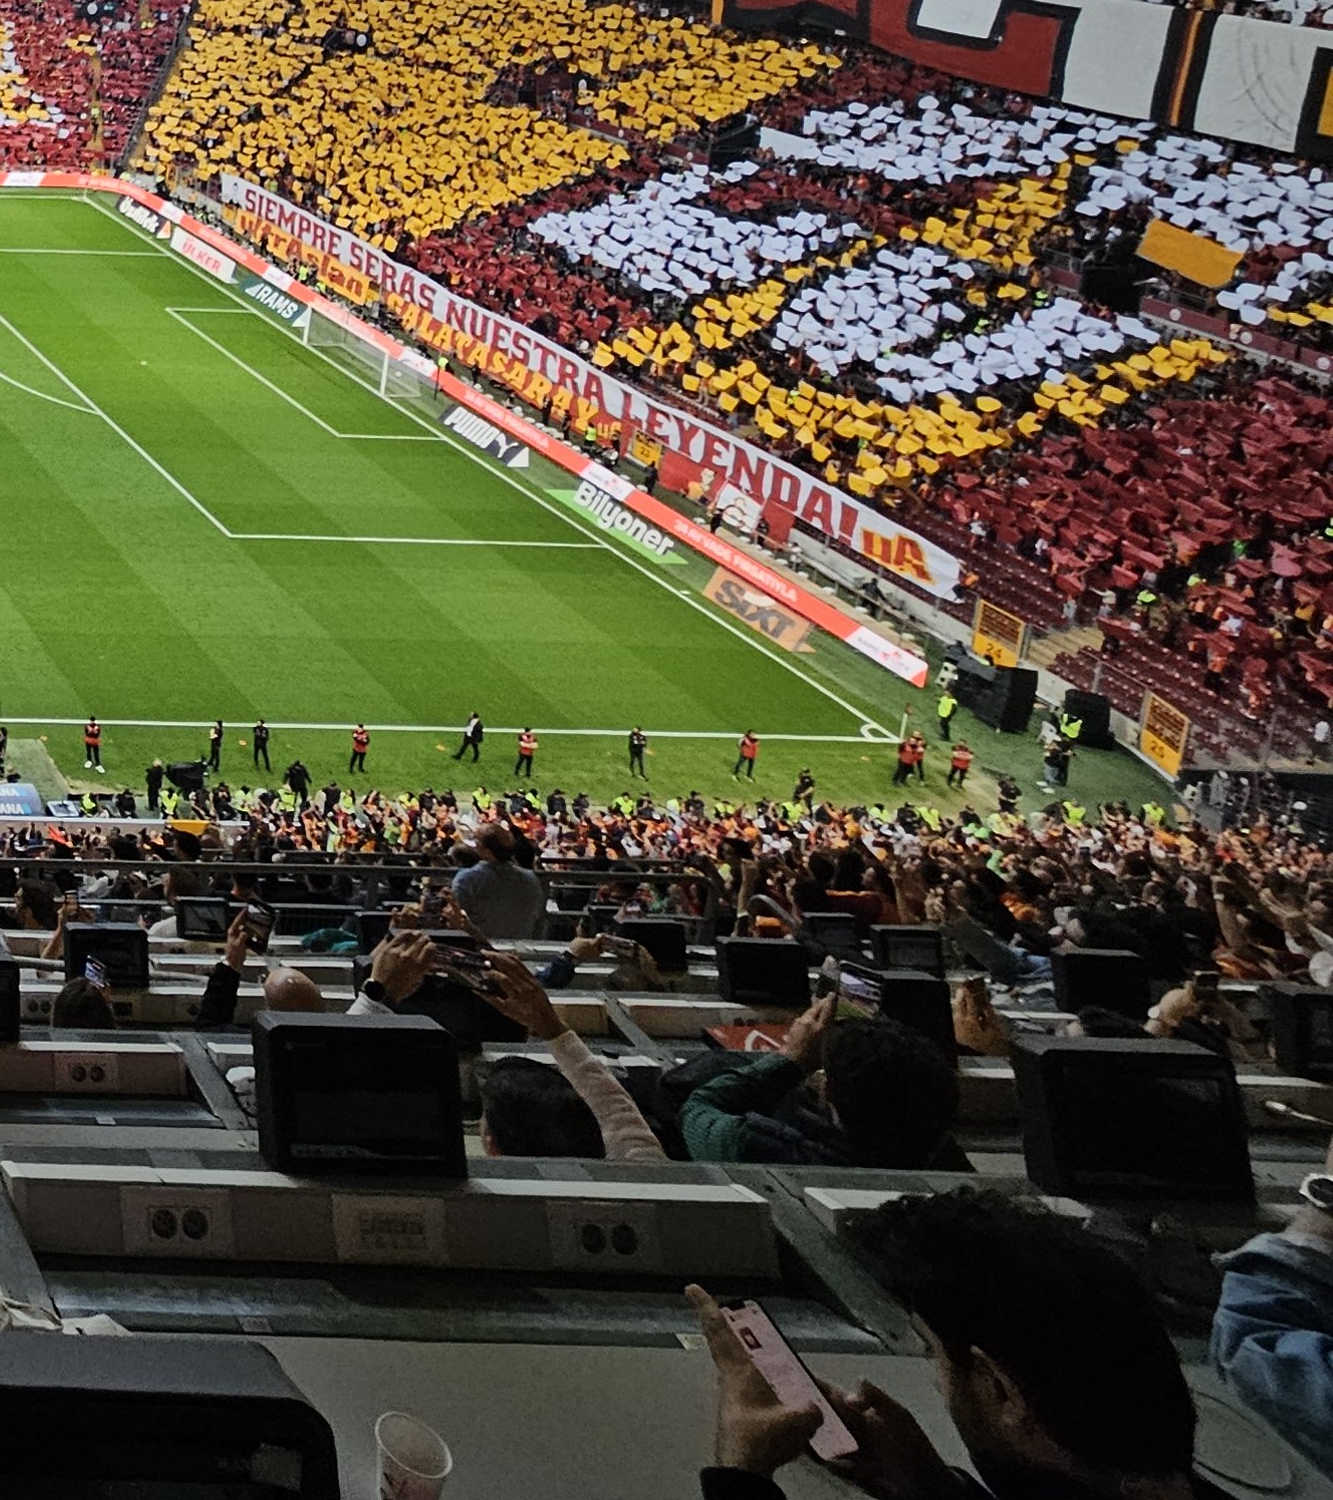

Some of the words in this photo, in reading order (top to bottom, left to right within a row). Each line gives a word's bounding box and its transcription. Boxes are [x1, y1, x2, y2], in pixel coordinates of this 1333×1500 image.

[182, 238, 221, 273] ÜLKER
[257, 284, 299, 319] RAMS
[245, 186, 342, 259] SIEMPRE
[349, 242, 436, 310] SERÁS
[445, 299, 605, 406] NUESTRA
[619, 391, 859, 545] LEYENDA!
[386, 293, 598, 432] GALATASARAY
[574, 481, 674, 559] Bilyoner
[985, 642, 1002, 659] 24
